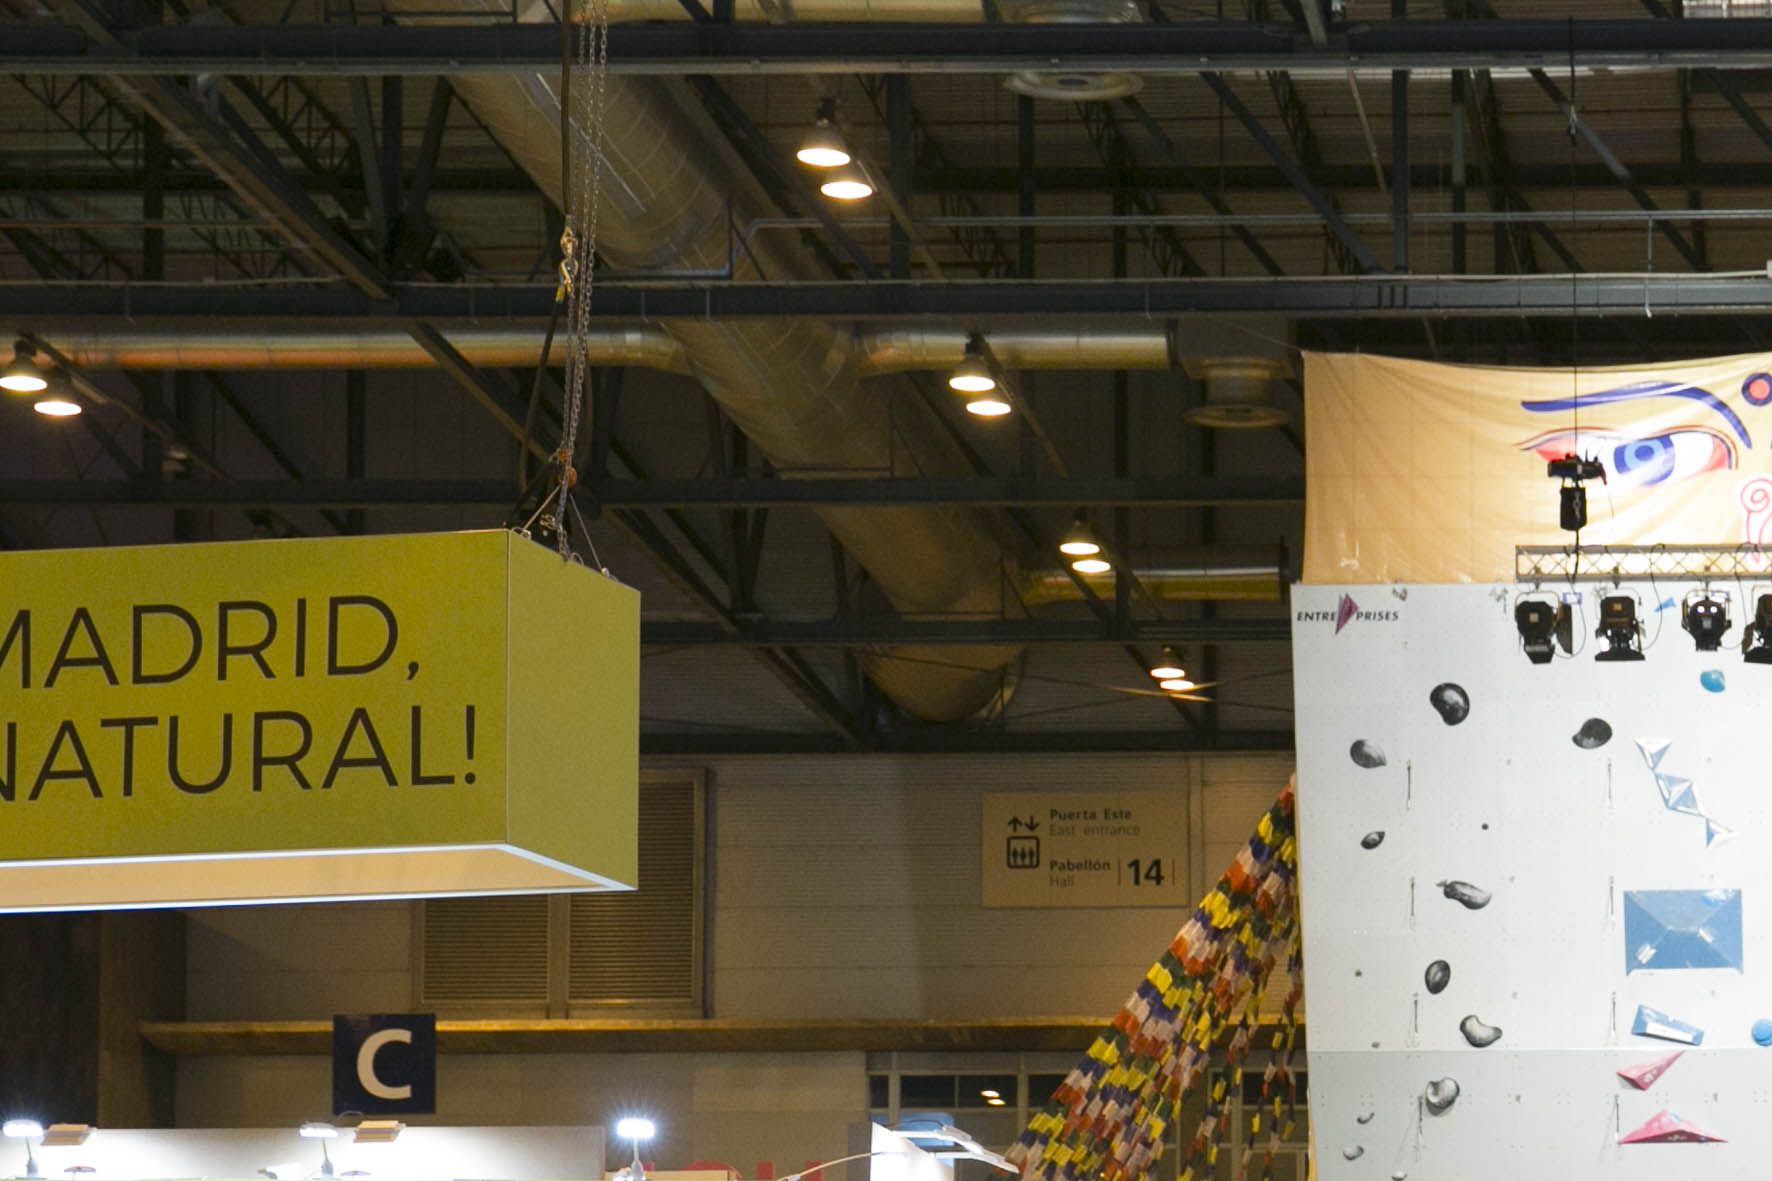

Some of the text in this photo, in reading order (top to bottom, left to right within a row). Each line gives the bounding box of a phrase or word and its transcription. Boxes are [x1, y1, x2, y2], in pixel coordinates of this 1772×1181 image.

[1297, 610, 1400, 622] ENTRE PRISES
[0, 704, 477, 801] ATURAL!
[1049, 808, 1132, 821] Puerta Este
[1049, 825, 1141, 837] East entrance
[1049, 859, 1165, 887] Pabellón 14
[1049, 875, 1075, 888] Hall
[356, 1027, 413, 1101] C
